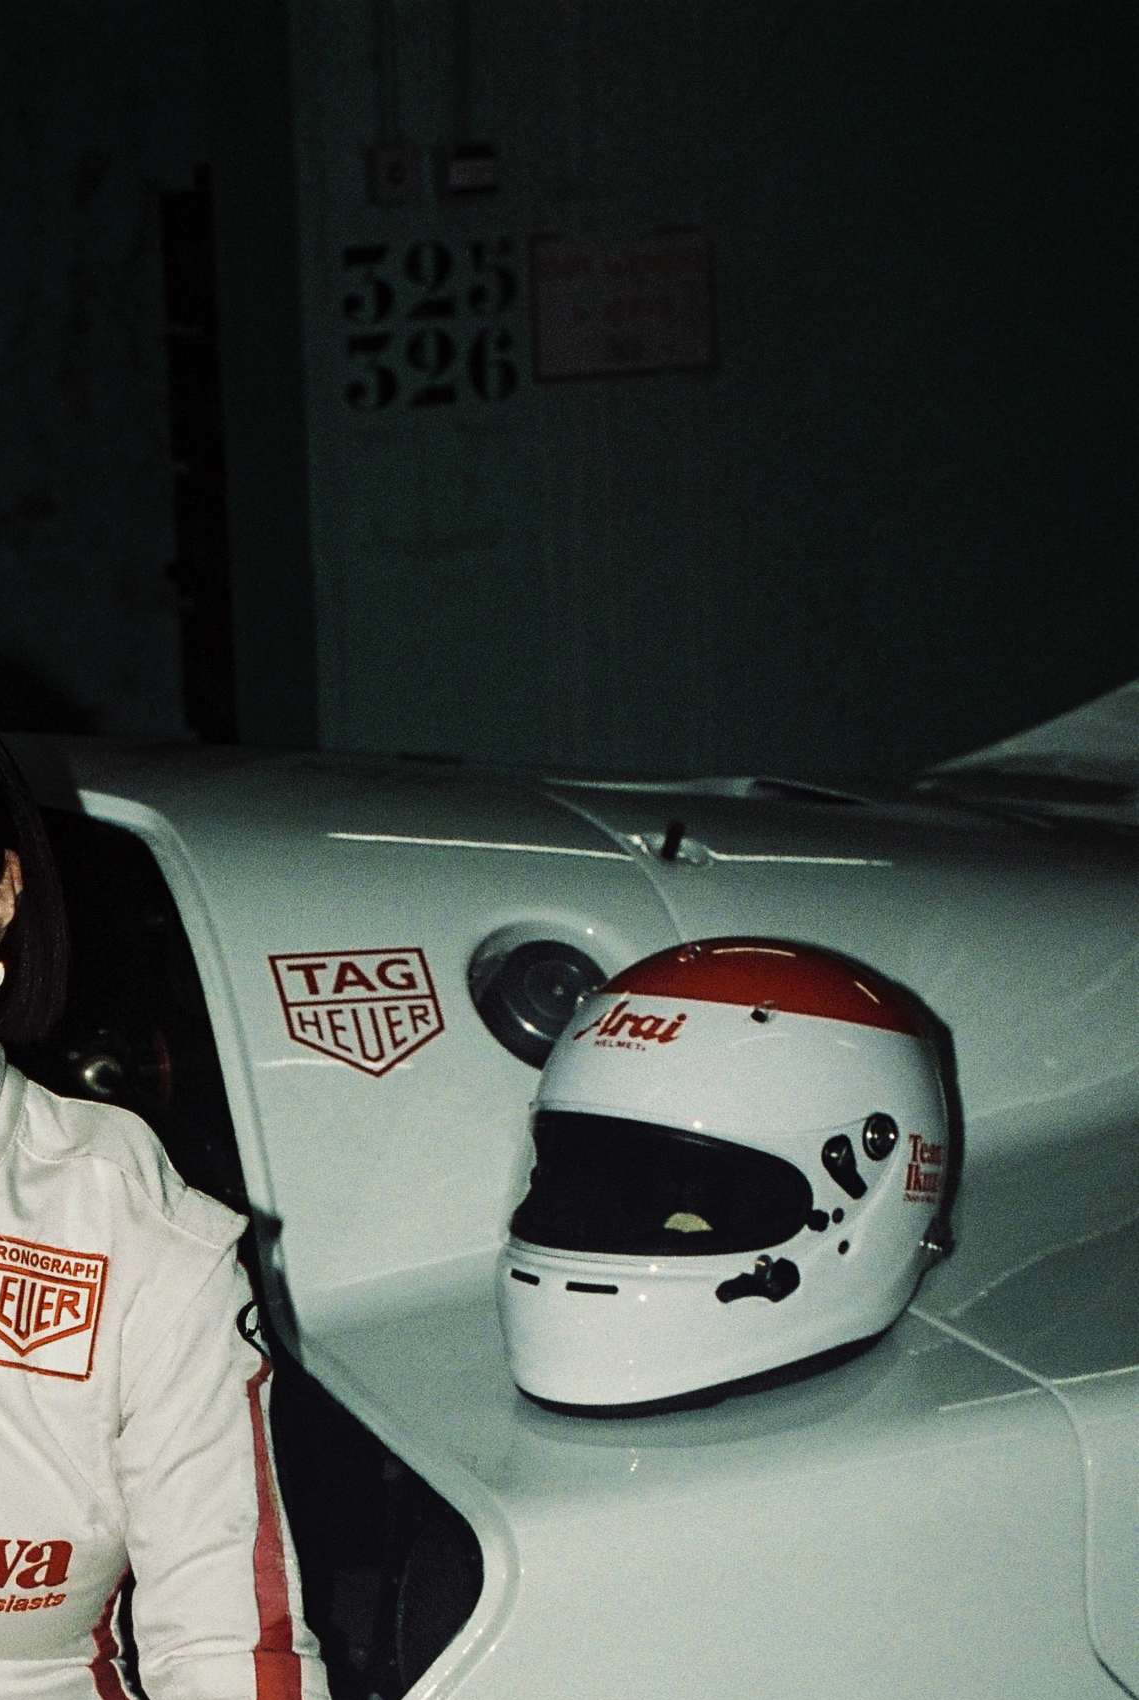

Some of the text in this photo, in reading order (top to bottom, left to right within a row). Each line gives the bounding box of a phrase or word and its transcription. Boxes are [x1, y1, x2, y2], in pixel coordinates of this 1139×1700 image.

[344, 236, 517, 325] 325
[347, 326, 517, 408] 326
[286, 958, 418, 995] TAG
[297, 1004, 431, 1062] HEUER
[571, 1000, 687, 1045] Arai
